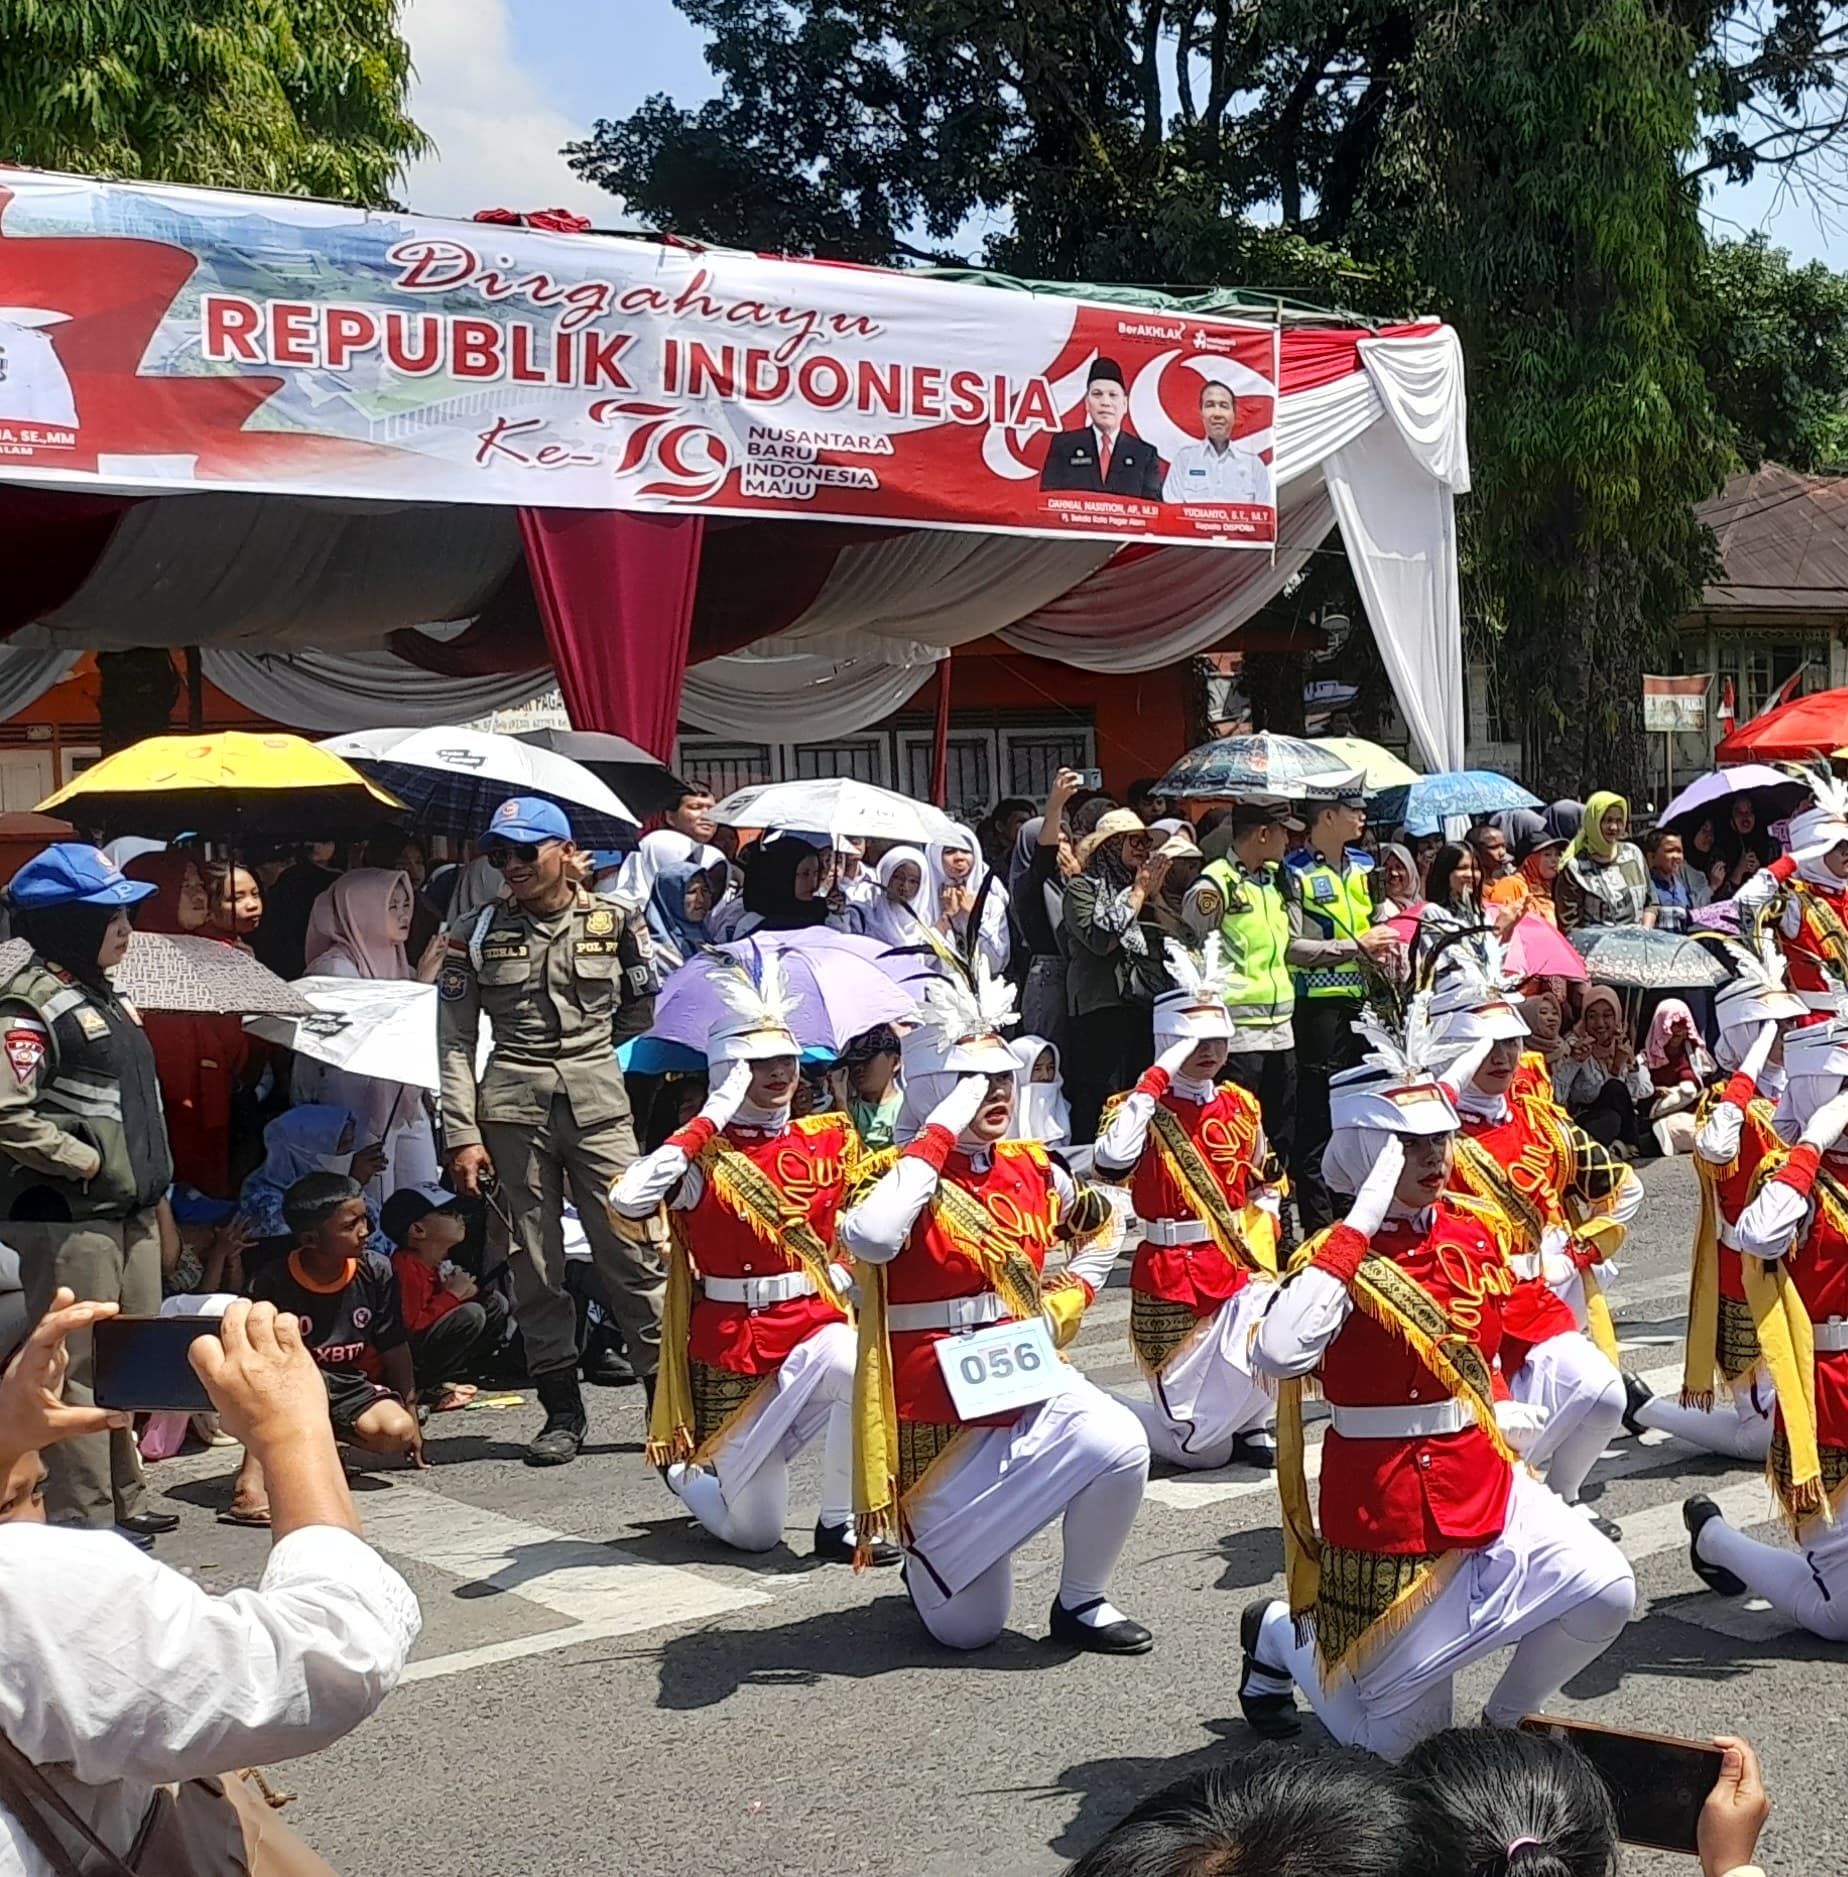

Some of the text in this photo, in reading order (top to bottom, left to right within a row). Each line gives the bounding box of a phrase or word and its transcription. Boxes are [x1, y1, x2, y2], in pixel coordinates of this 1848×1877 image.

[391, 241, 880, 363] Dirgahayu
[1118, 321, 1185, 341] BerAKHLAK
[207, 296, 1057, 428] REPUBLIK INDONESIA
[476, 399, 728, 498] Ke- 79
[748, 426, 889, 450] NUSANTARA
[747, 442, 812, 460] BARU
[746, 462, 875, 485] INDONESIA
[745, 480, 811, 495] MAJU
[576, 942, 603, 953] POL
[960, 1342, 1041, 1385] 056
